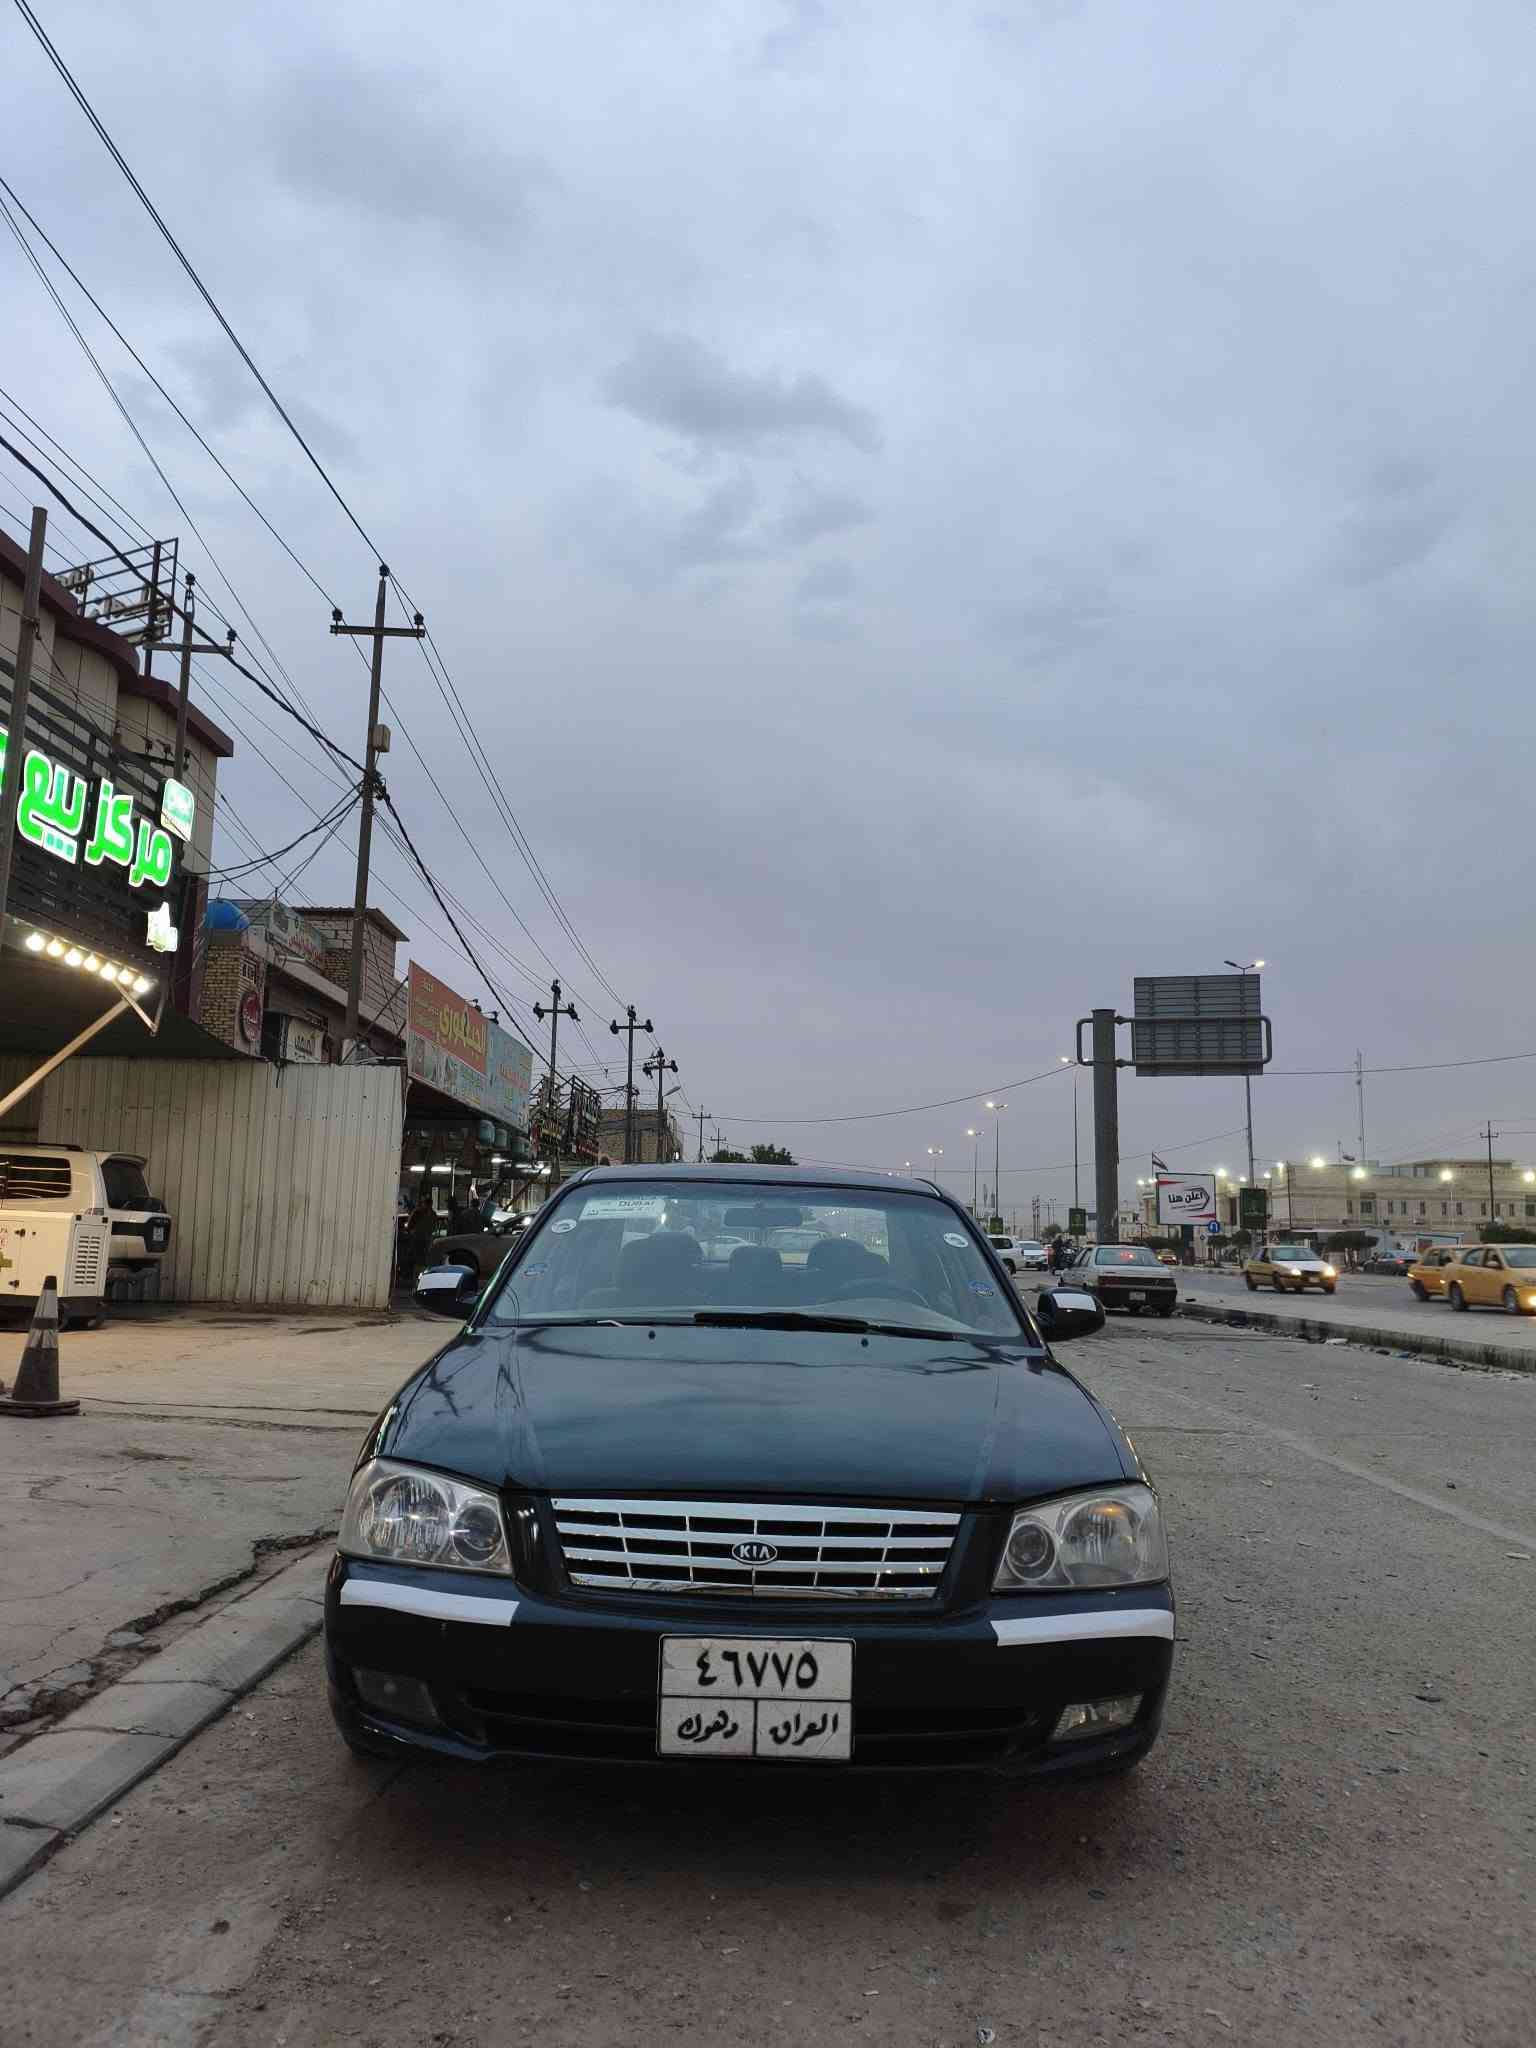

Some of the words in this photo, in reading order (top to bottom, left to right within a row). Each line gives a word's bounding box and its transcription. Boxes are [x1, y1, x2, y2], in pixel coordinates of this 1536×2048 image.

[17, 750, 87, 864] بيع
[85, 777, 172, 887] مركز
[1168, 1192, 1183, 1203] هنا
[738, 1544, 770, 1559] KIA
[696, 1649, 818, 1691] ٤٦٧٧٥
[677, 1709, 740, 1744] دهوك
[768, 1711, 839, 1747] العراق
